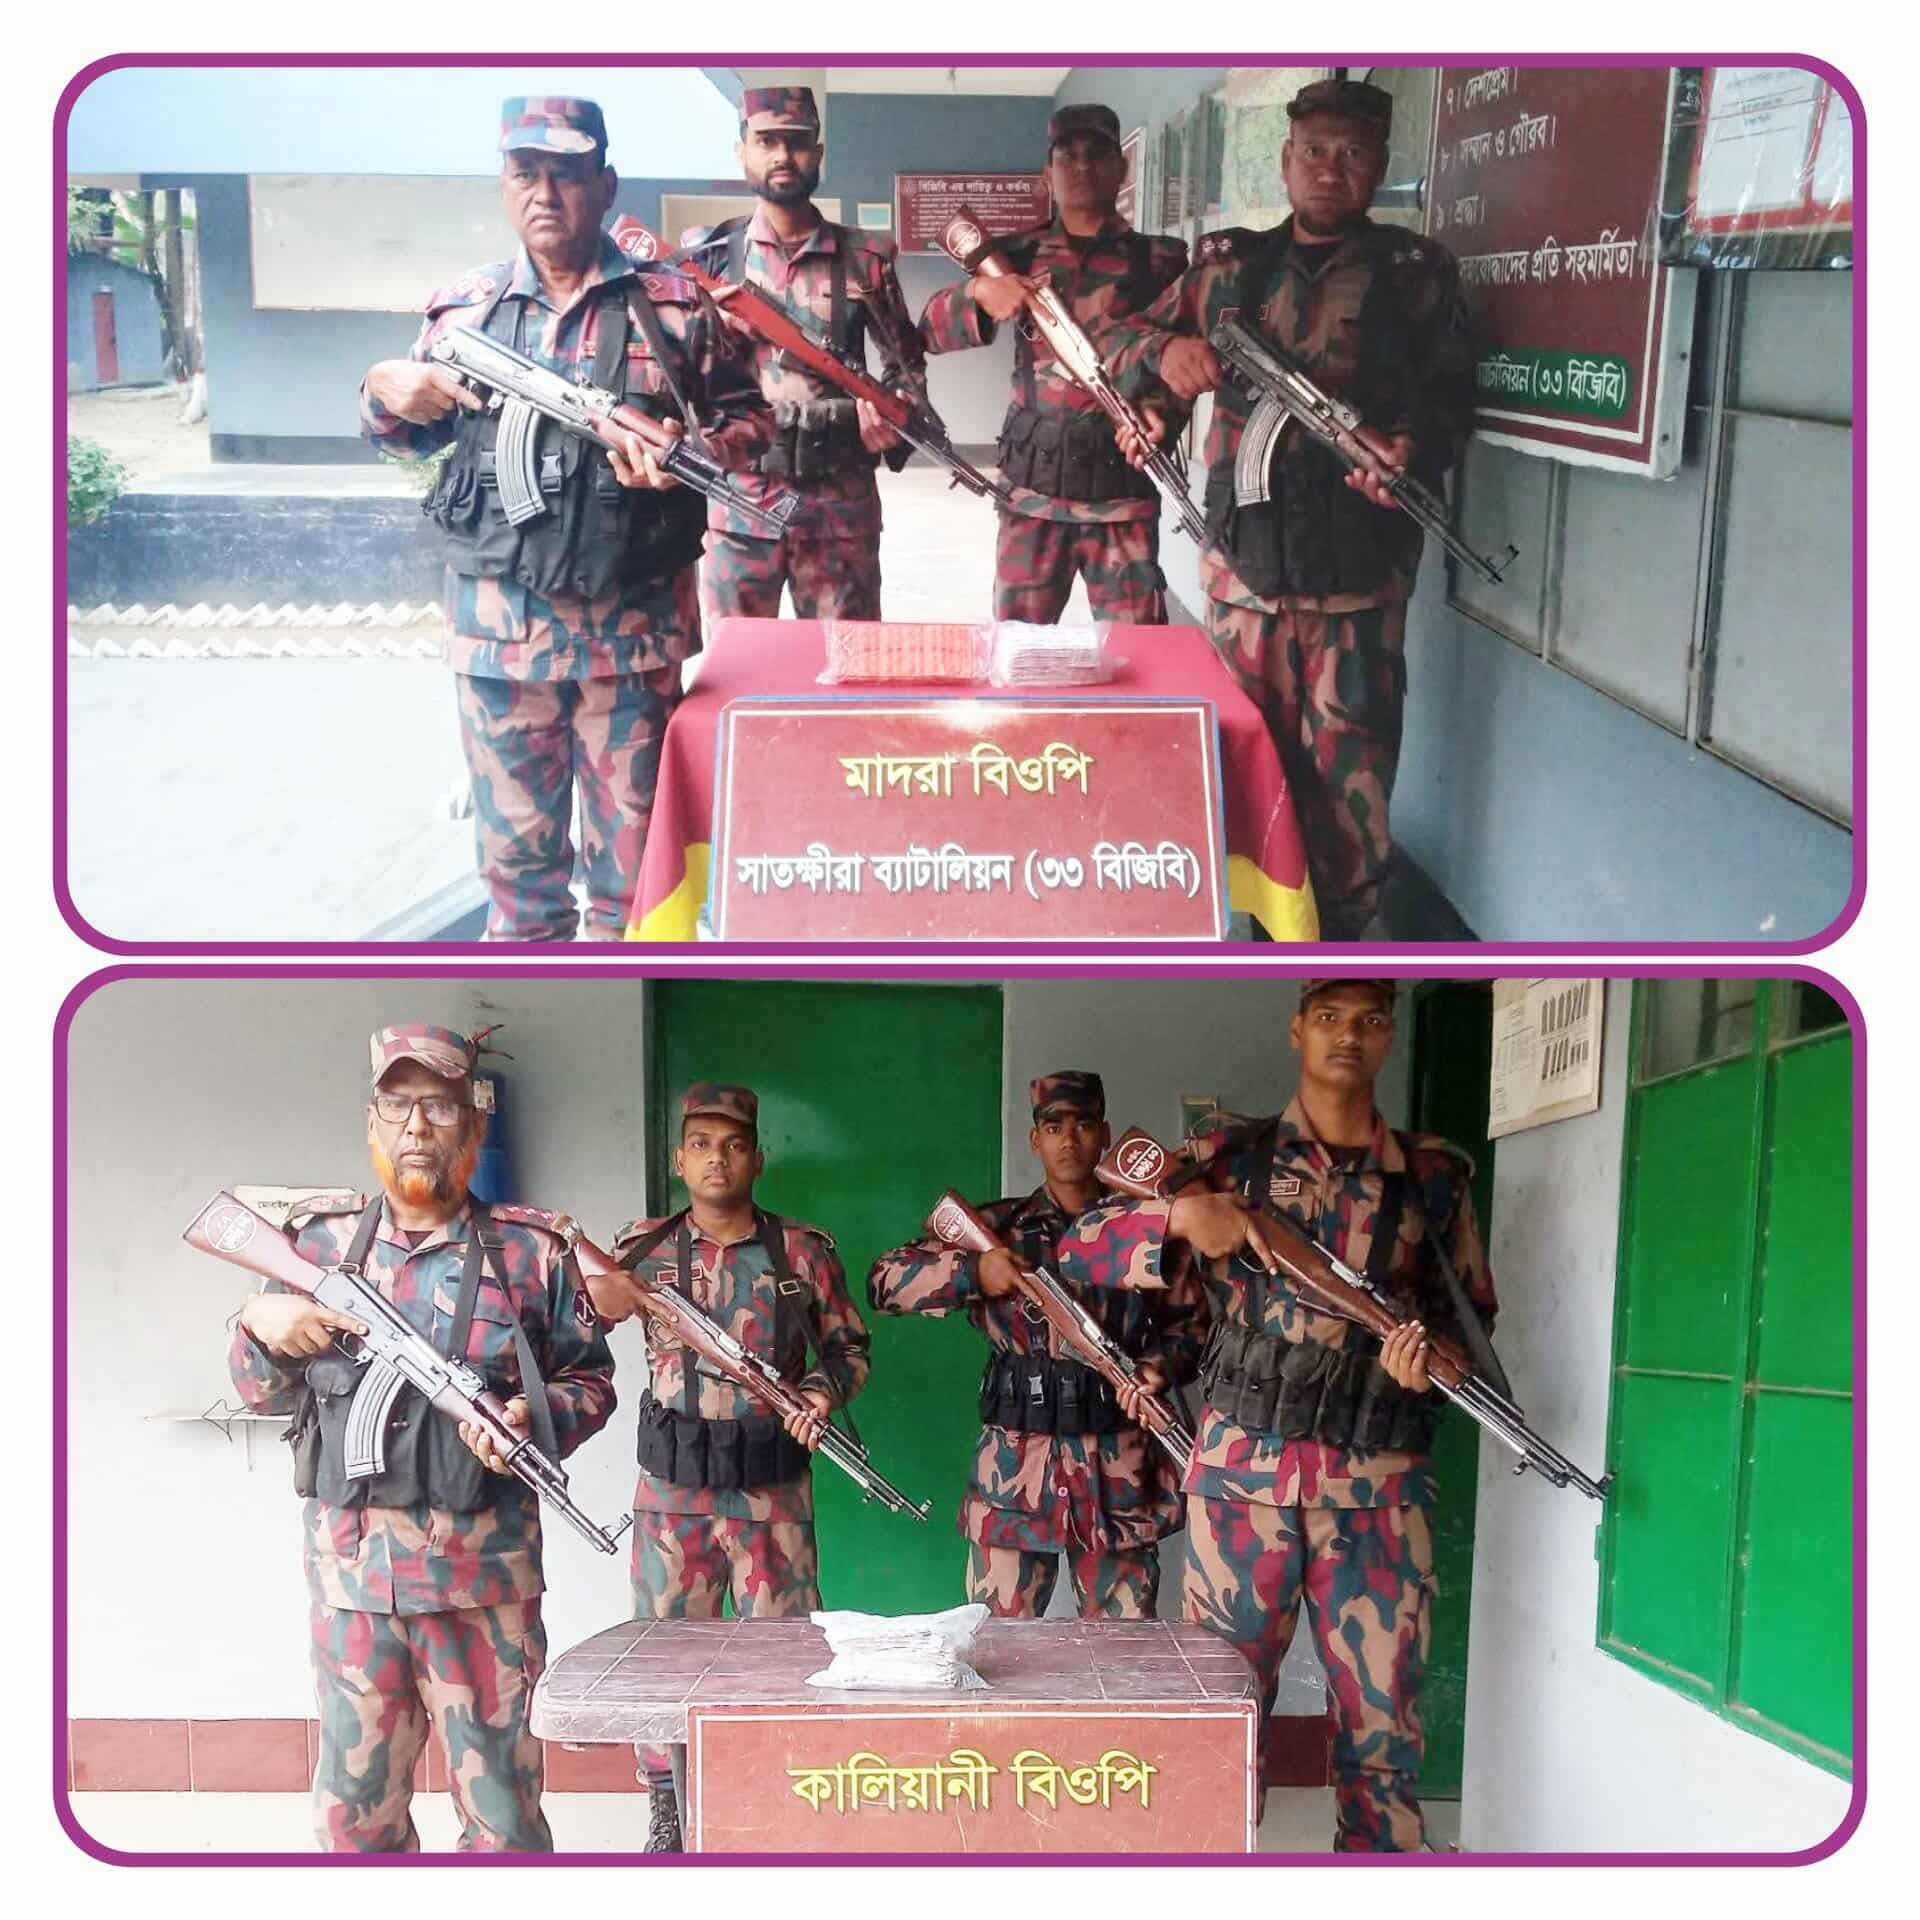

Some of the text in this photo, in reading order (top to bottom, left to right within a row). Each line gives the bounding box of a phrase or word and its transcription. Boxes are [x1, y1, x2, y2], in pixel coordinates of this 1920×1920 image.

[1495, 129, 1505, 157] ও
[1531, 235, 1562, 283] প্রতি
[1532, 360, 1562, 398] (৩৩
[1566, 358, 1627, 409] বিজিবি)
[840, 741, 1095, 798] মাদরা বিওপি
[736, 841, 1201, 898] সাতক্ষীরা ব্যাটালিয়ন (৩৩ বিজিবি)
[787, 1749, 1158, 1813] কালিয়ানী বিওপি
